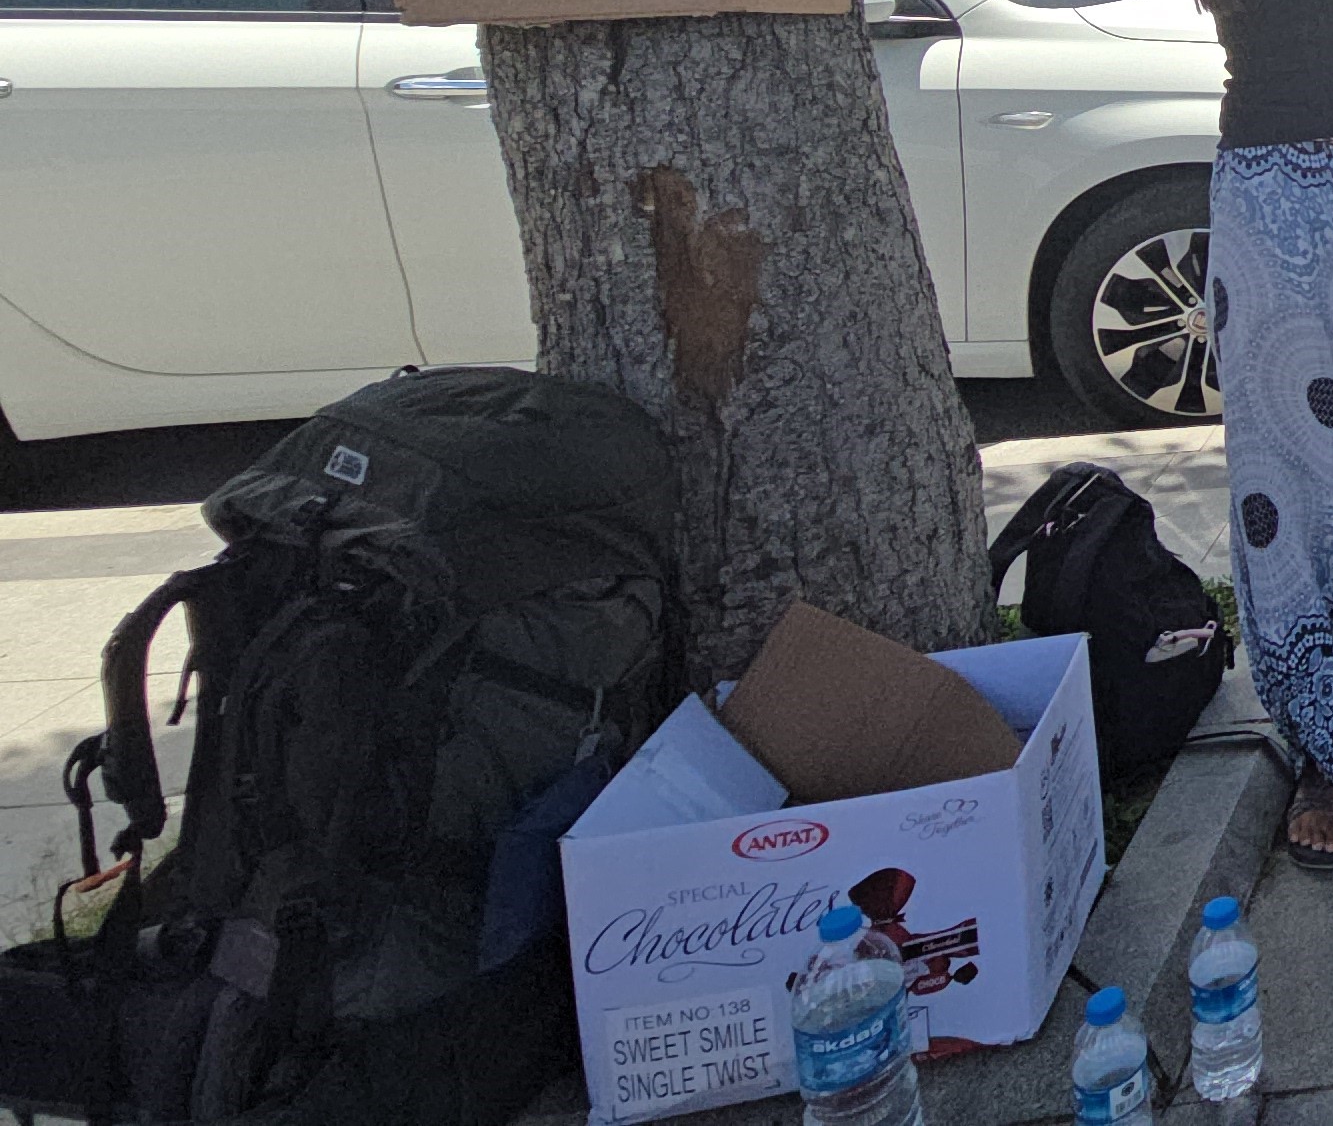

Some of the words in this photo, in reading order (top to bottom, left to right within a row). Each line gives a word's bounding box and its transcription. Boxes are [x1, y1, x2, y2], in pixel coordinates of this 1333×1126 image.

[746, 827, 815, 854] ANTAT
[667, 881, 751, 906] SPECIAL
[585, 882, 840, 975] Chocolates
[625, 1011, 672, 1031] ITEM
[719, 998, 751, 1017] 138
[613, 1030, 692, 1067] SWEET
[699, 1017, 768, 1054] SMILE
[617, 1066, 696, 1104] SINGLE
[702, 1052, 771, 1091] TWIST
